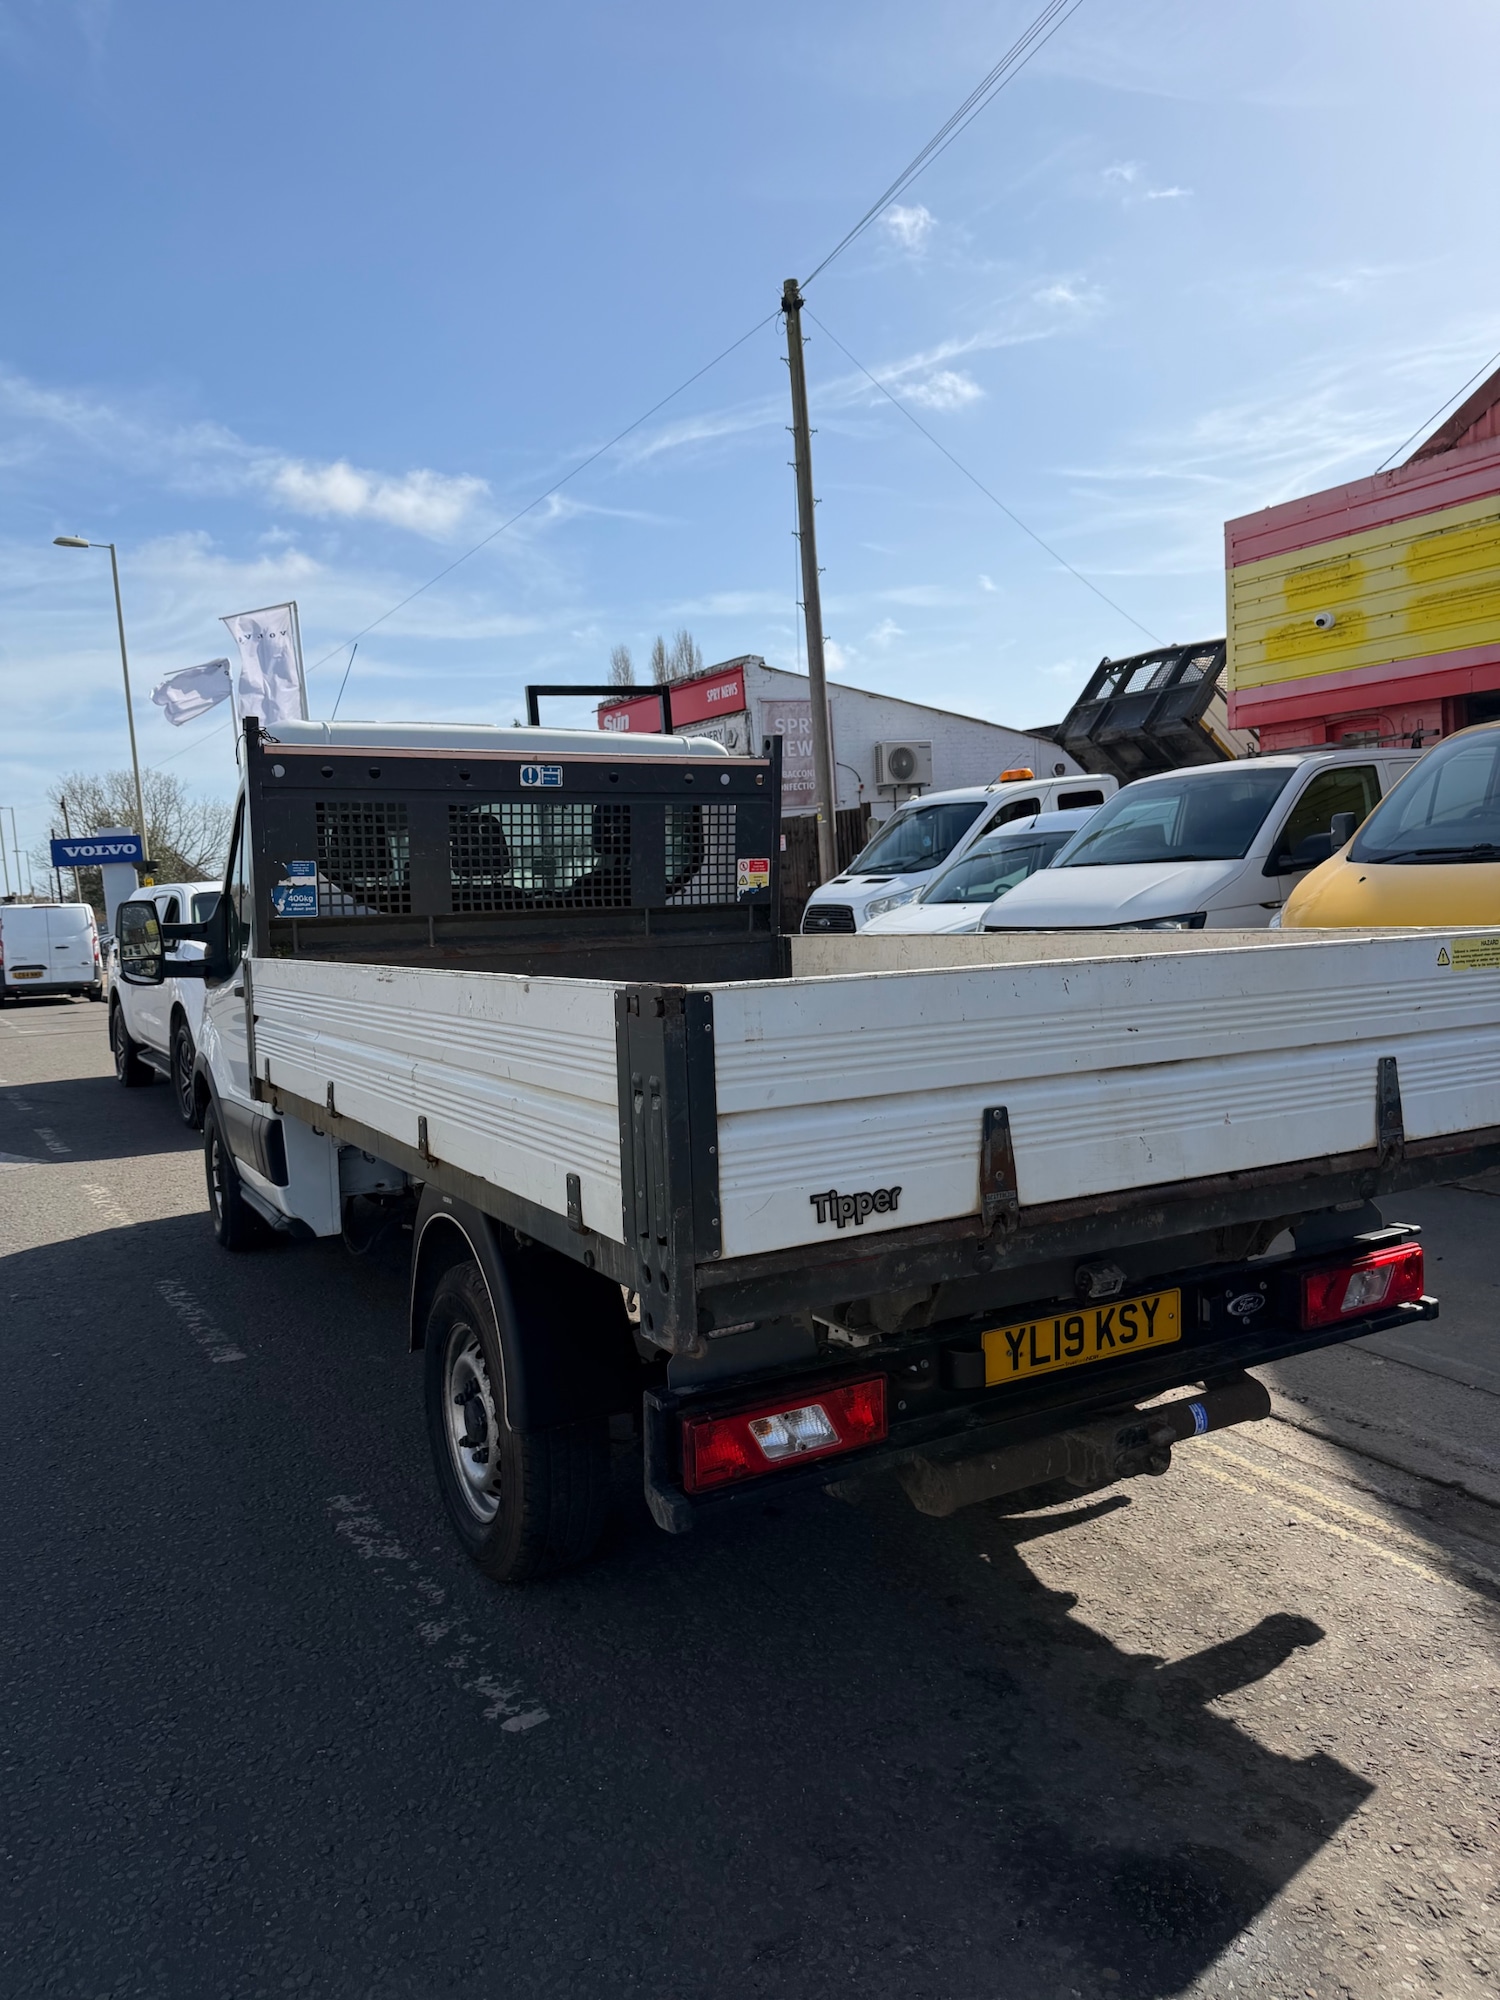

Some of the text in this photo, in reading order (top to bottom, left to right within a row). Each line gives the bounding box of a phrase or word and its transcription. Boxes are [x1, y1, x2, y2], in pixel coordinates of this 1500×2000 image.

[706, 682, 738, 702] SPRY NEWS
[774, 717, 813, 735] SPR
[782, 740, 813, 757] EW
[782, 769, 815, 778] BACCONI
[62, 844, 137, 857] VOLVO
[288, 895, 313, 903] 400kg
[810, 1186, 902, 1228] Tipper
[1005, 1297, 1160, 1371] YL19 KSY
